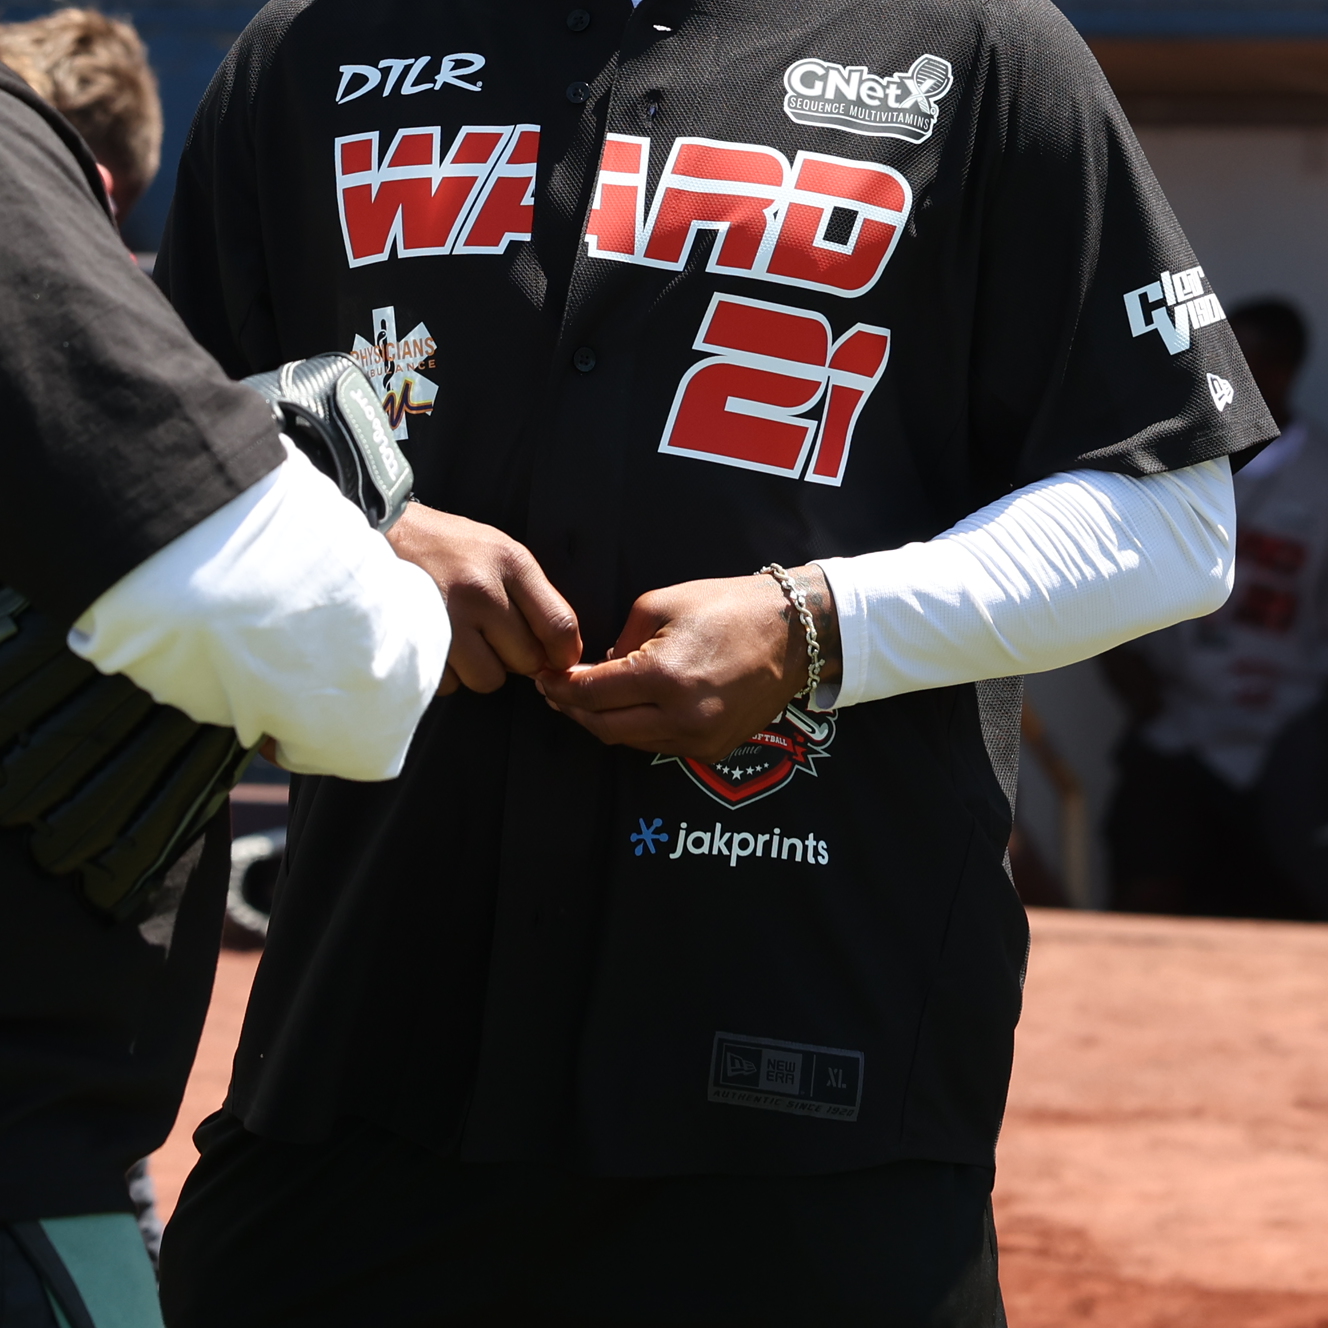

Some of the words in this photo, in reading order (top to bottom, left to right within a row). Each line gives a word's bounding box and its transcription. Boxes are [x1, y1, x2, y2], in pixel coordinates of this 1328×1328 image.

[335, 52, 486, 105] DTLR
[789, 56, 951, 114] GNetX
[789, 96, 846, 114] SEQUENCE
[849, 104, 930, 130] MULTIVITAMINS
[335, 124, 913, 299] WARD
[349, 337, 435, 369] PHYSICIANS
[367, 359, 437, 378] BULANCE
[658, 292, 890, 487] 21
[752, 733, 788, 747] FTBALL
[669, 821, 830, 867] jakprints
[765, 1071, 795, 1085] ERA
[766, 1058, 796, 1073] NEW
[826, 1066, 847, 1089] XL
[713, 1089, 781, 1106] AUTHENTIC
[786, 1100, 821, 1113] SINCE
[826, 1105, 855, 1117] 1920
